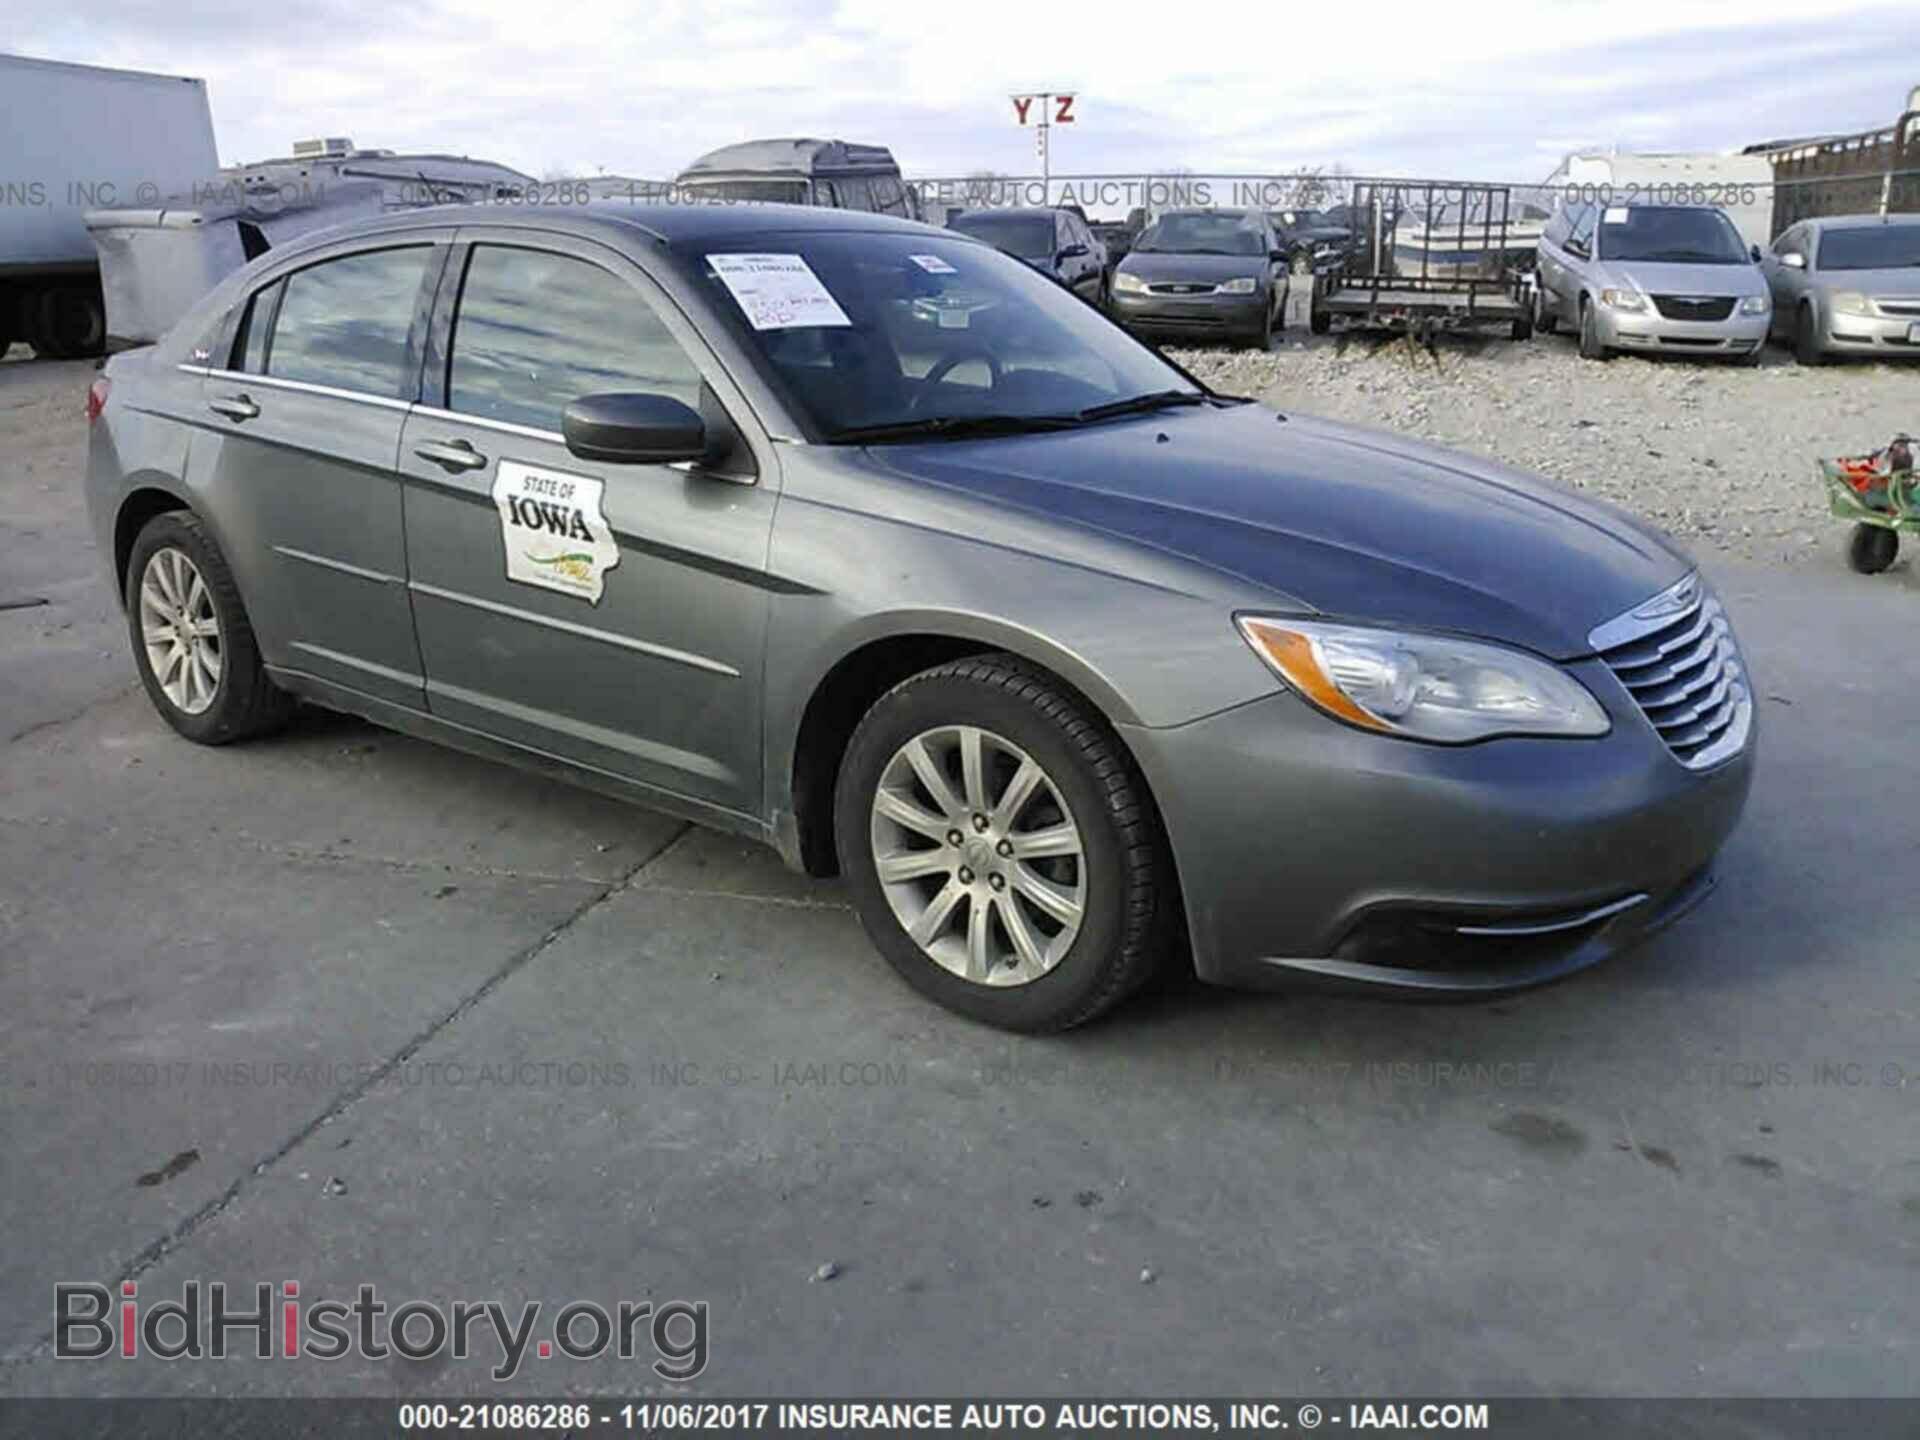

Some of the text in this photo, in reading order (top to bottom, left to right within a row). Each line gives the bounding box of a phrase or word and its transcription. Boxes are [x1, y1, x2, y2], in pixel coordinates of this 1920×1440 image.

[1012, 96, 1075, 125] Y Z
[523, 475, 577, 499] STATE OF
[507, 494, 596, 543] IOWA
